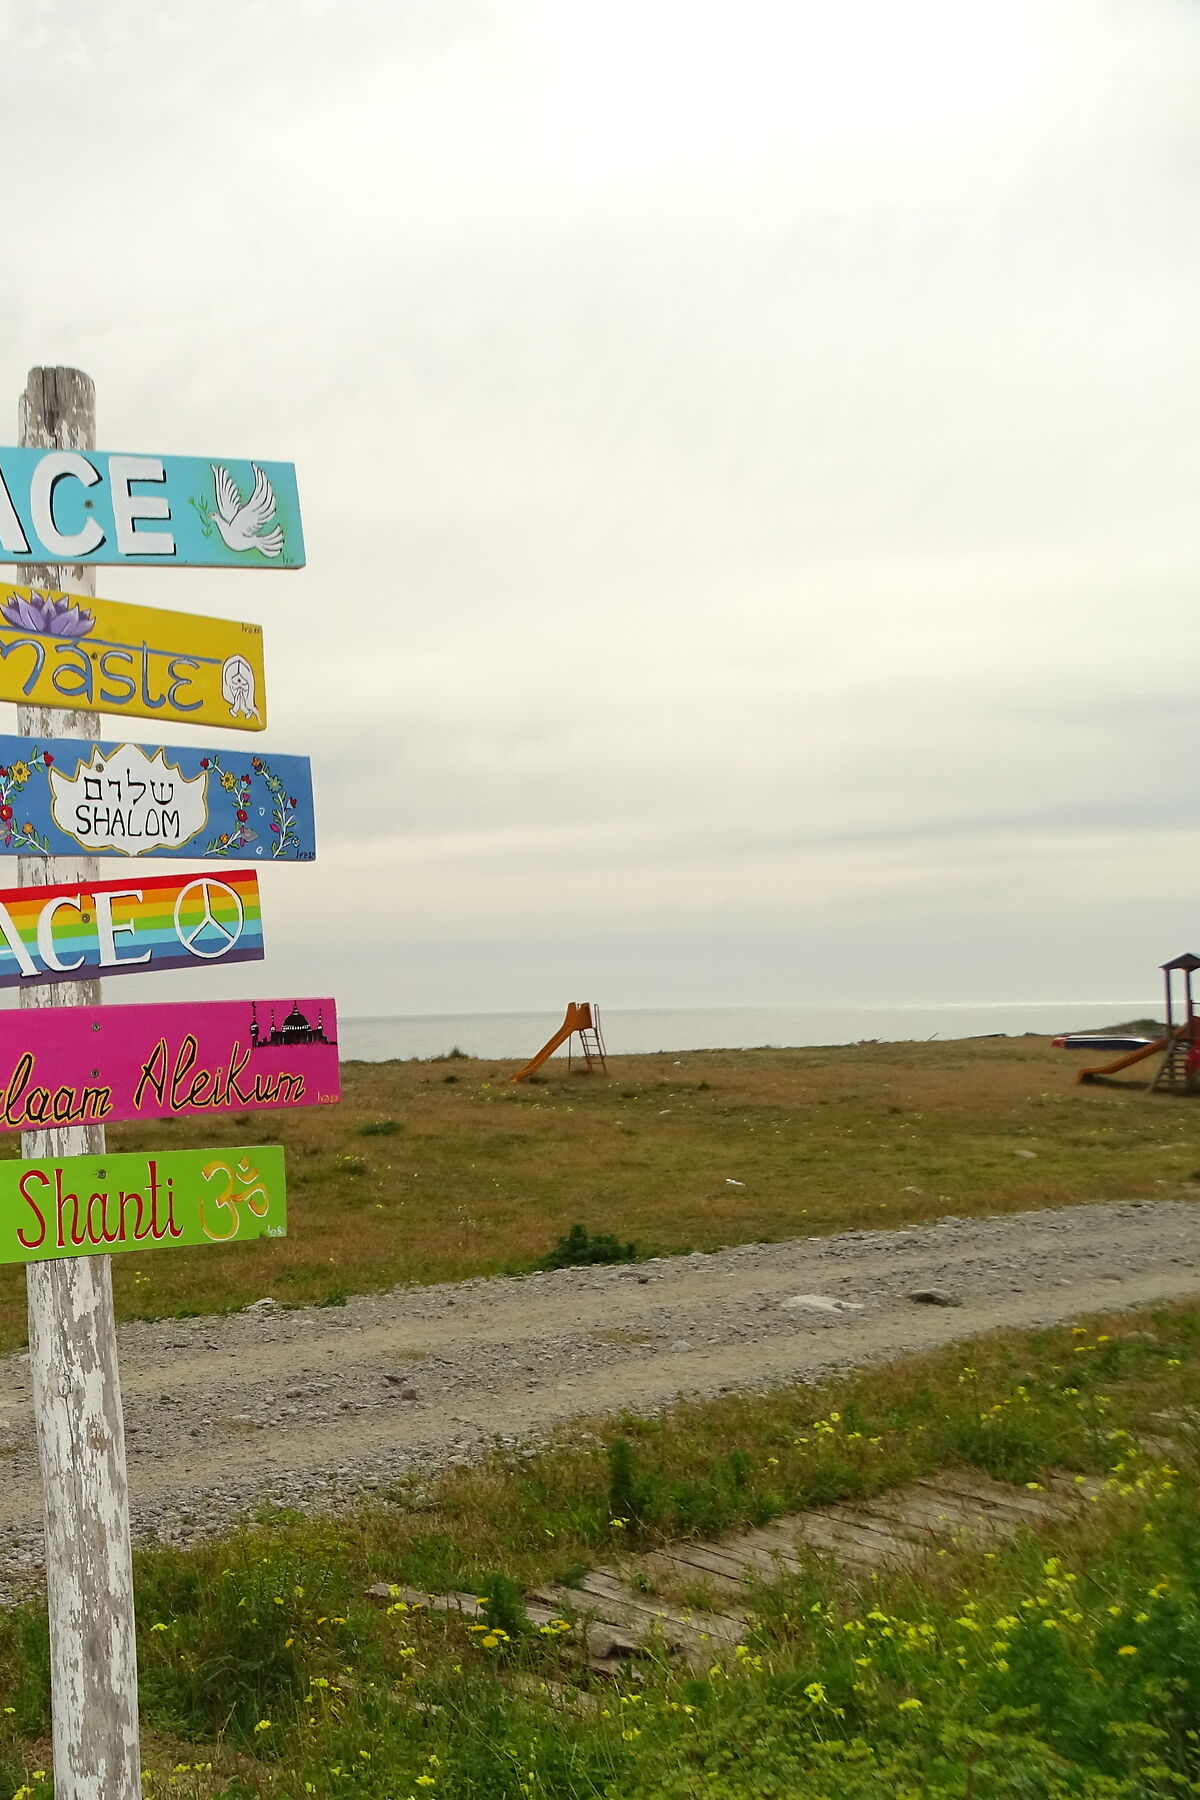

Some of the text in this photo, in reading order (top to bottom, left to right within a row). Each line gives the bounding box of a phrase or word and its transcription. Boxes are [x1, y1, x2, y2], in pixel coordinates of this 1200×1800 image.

[84, 768, 175, 805] שלום
[75, 804, 181, 838] SHALOM
[17, 1160, 184, 1250] Shanti
